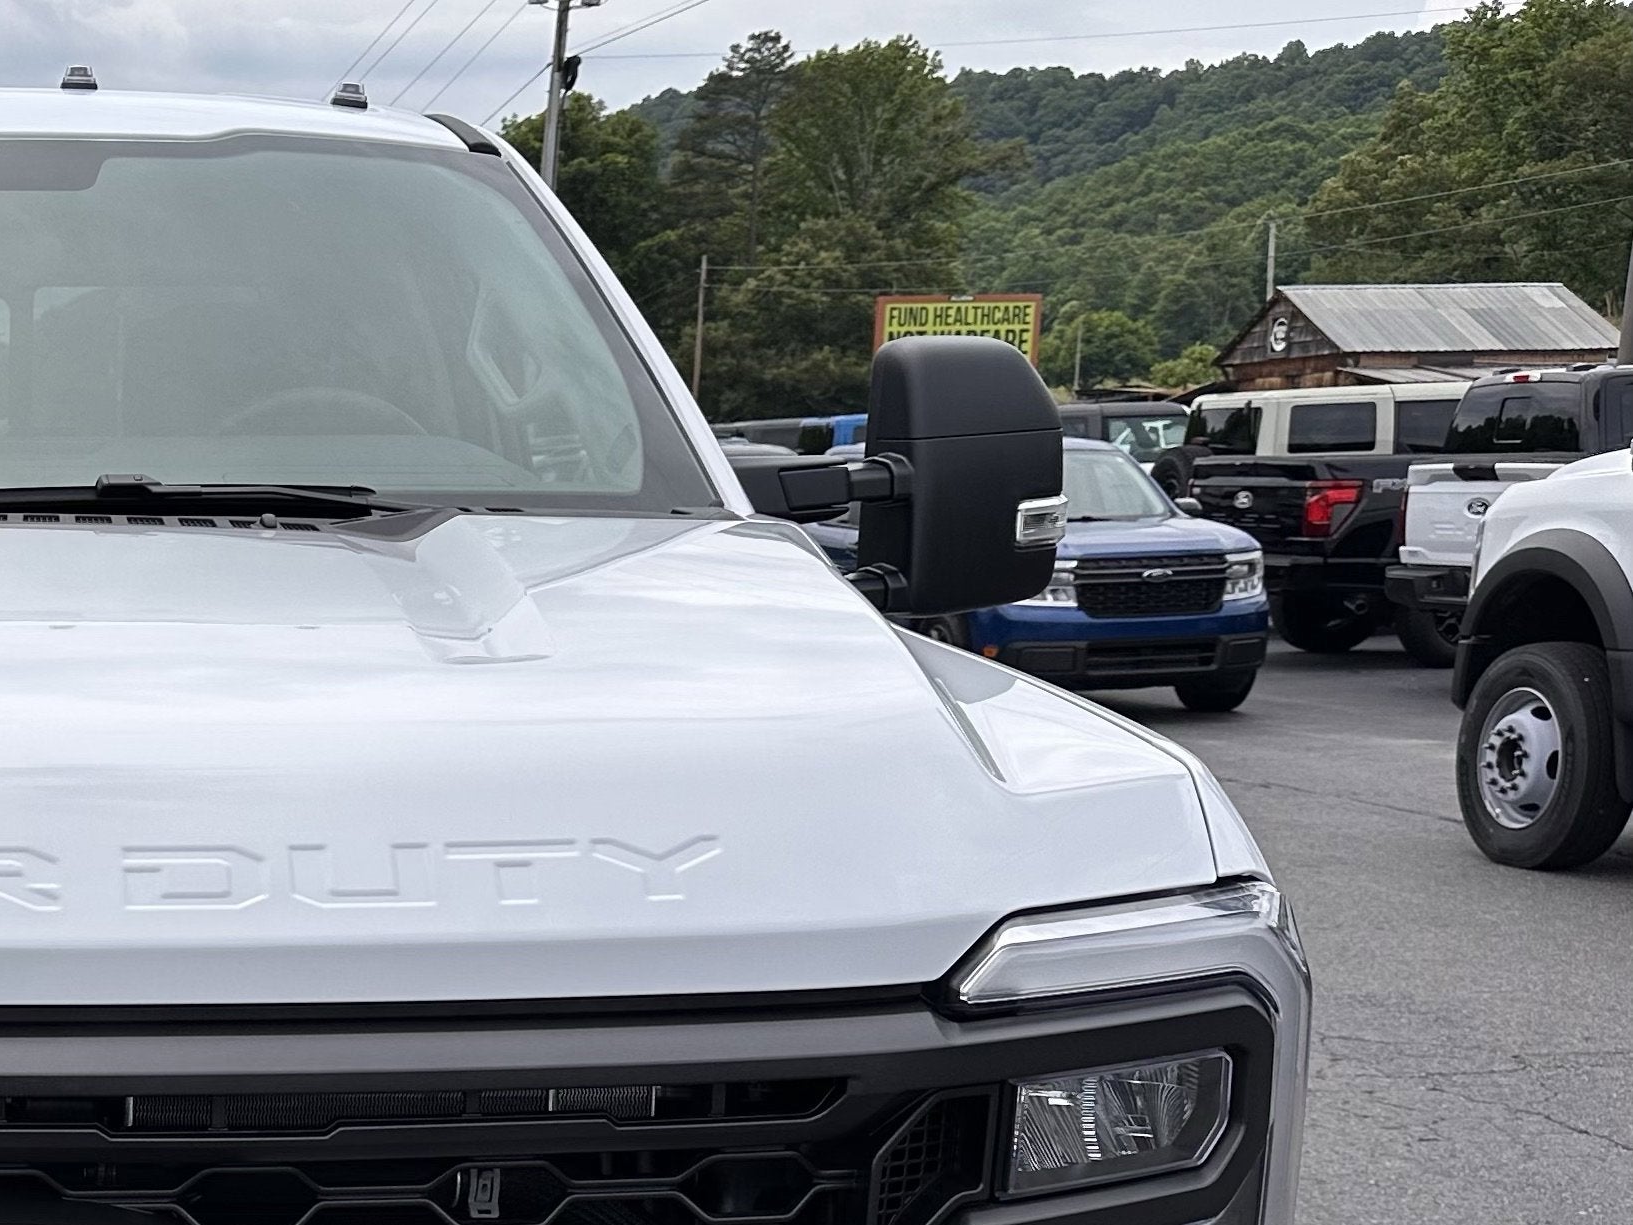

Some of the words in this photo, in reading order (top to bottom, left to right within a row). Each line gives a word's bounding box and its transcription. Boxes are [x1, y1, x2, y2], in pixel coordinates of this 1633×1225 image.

[888, 307, 928, 327] FUND
[933, 305, 1031, 326] HEALTHCARE
[120, 833, 723, 910] DUTY
